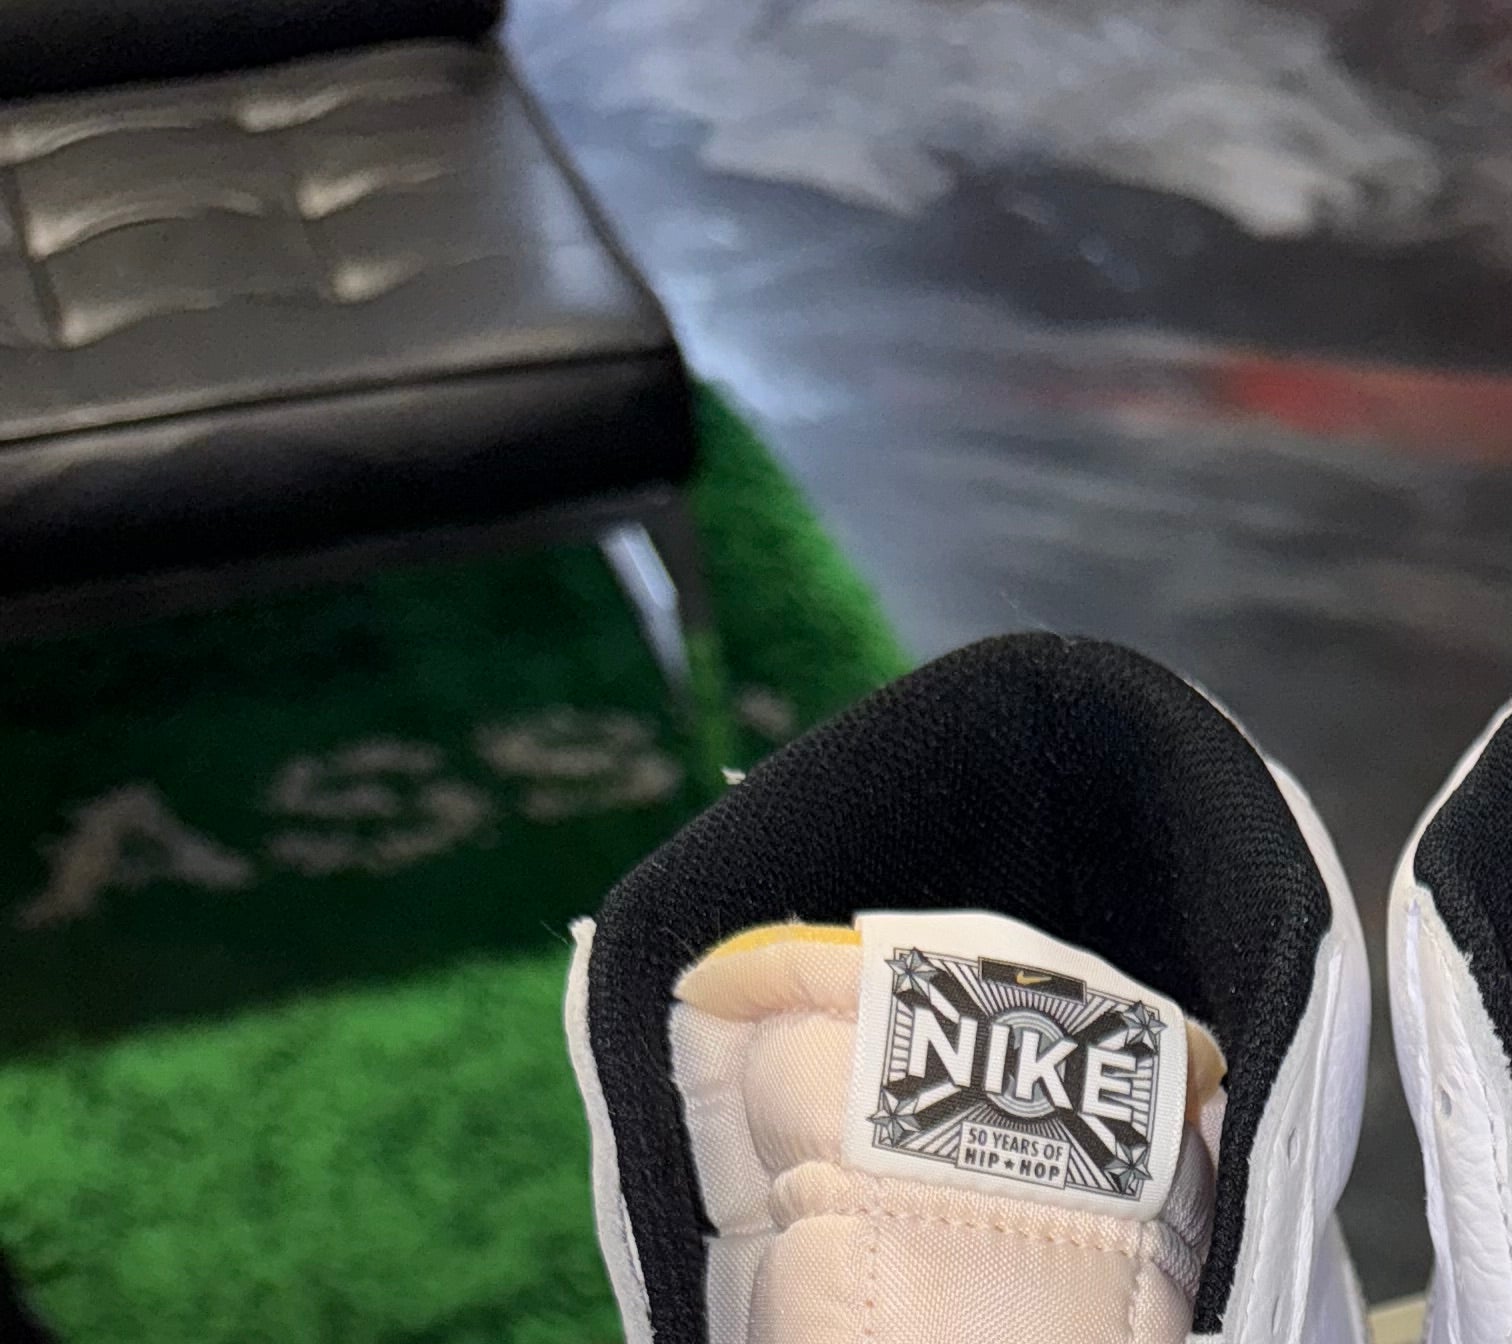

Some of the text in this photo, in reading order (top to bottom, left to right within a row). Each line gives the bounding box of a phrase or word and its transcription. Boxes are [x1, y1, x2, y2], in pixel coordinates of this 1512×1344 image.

[908, 1007, 1138, 1121] NIKE
[968, 1127, 1064, 1162] 50 YEARS OF
[964, 1148, 1060, 1181] HIP HOP
